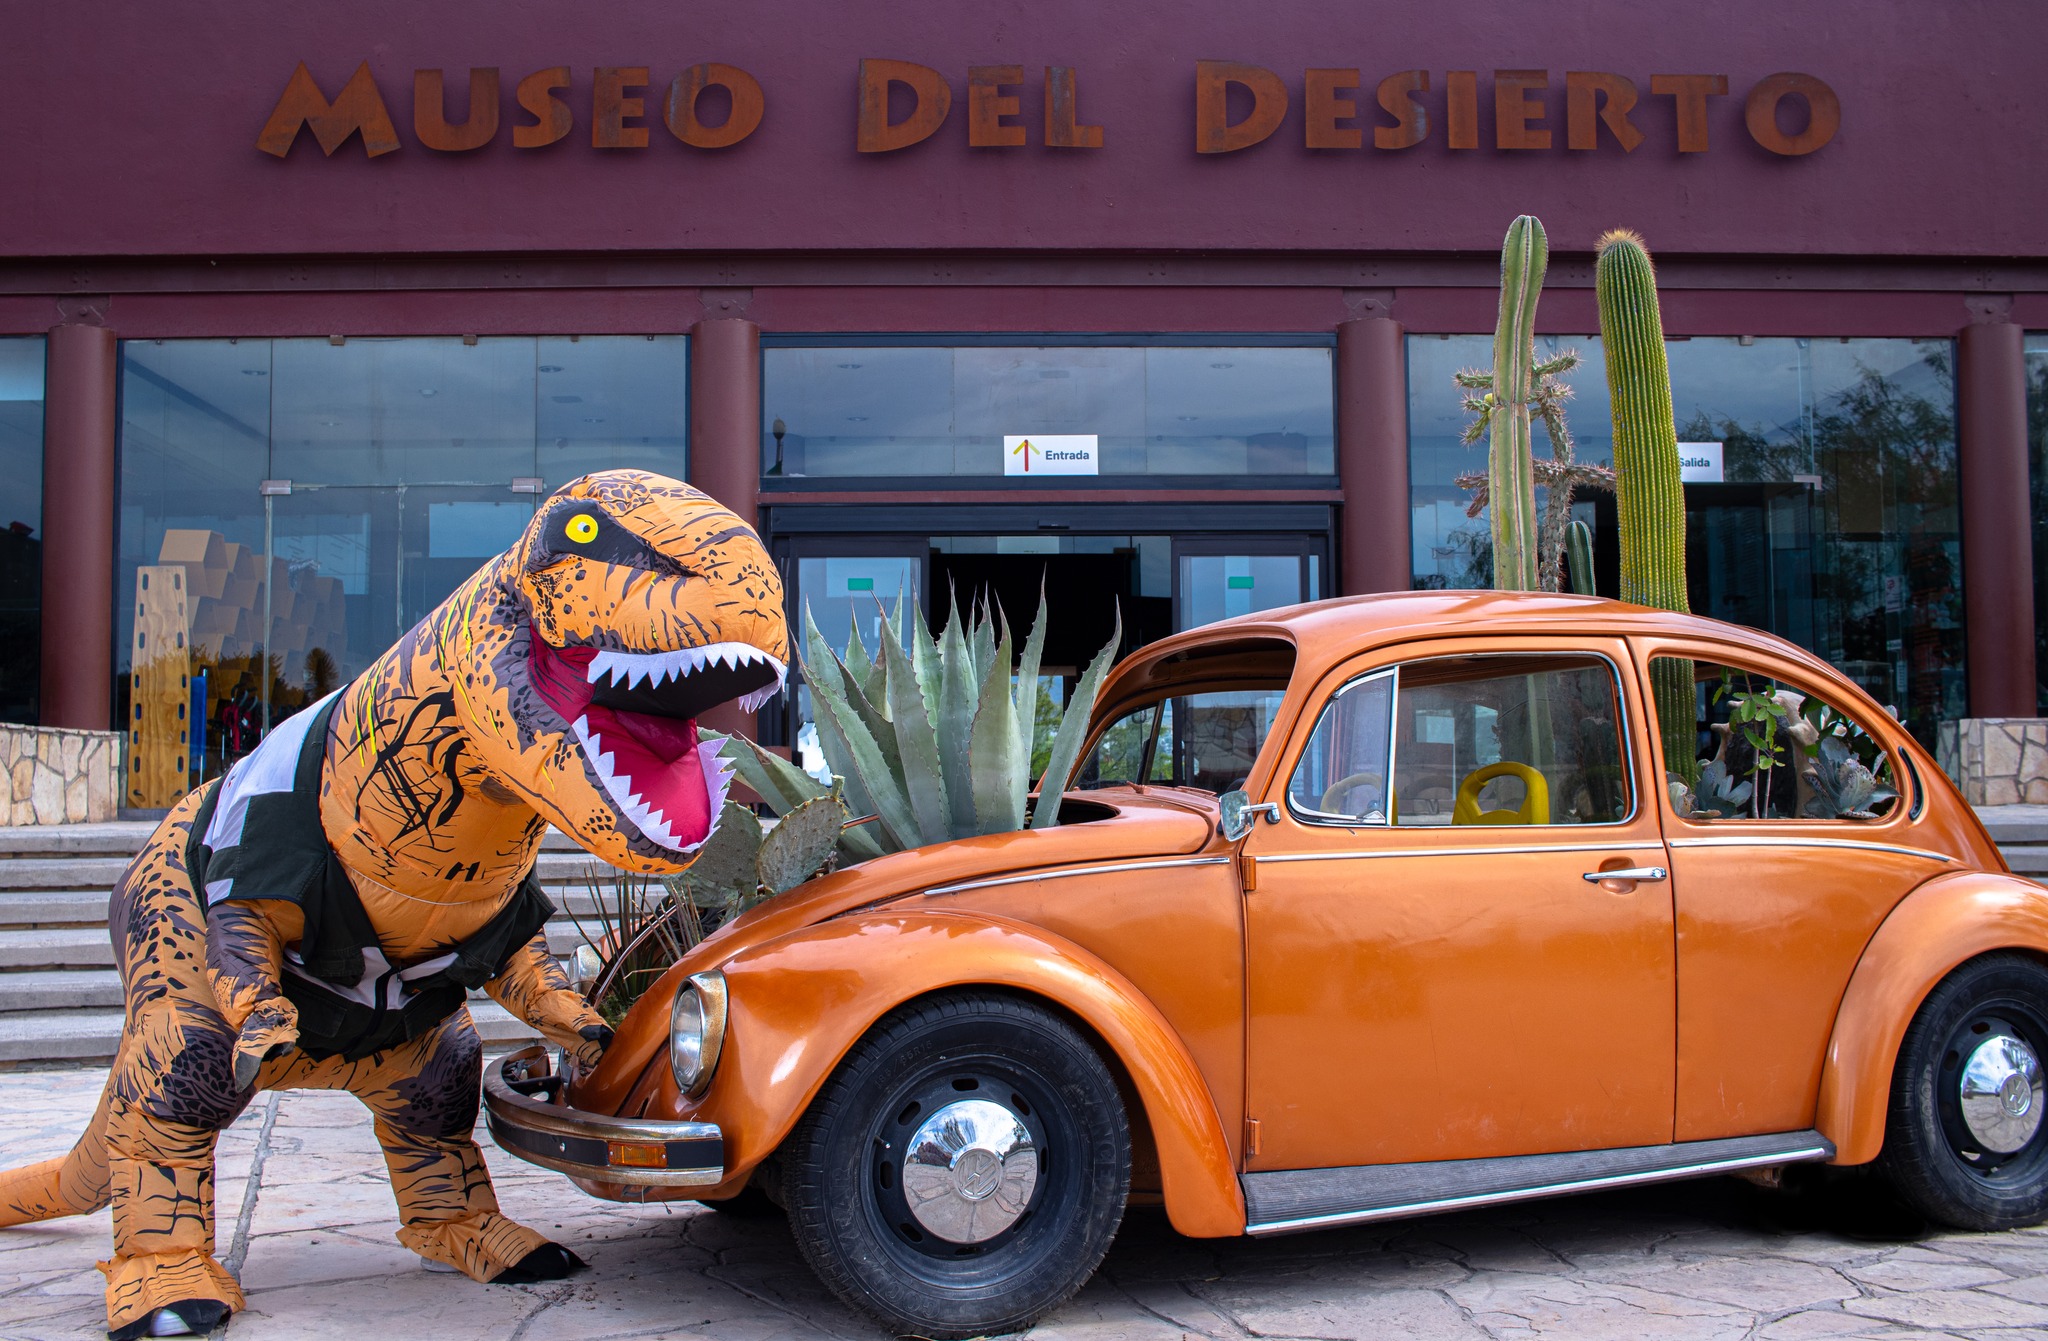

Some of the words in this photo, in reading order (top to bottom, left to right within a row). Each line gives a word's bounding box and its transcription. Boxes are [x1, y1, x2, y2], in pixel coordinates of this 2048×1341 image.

[256, 60, 765, 159] MUSEO
[857, 58, 1103, 153] DEL
[1196, 59, 1841, 156] DESIERTO
[1045, 449, 1090, 460] Entrada
[1679, 457, 1711, 467] Salida
